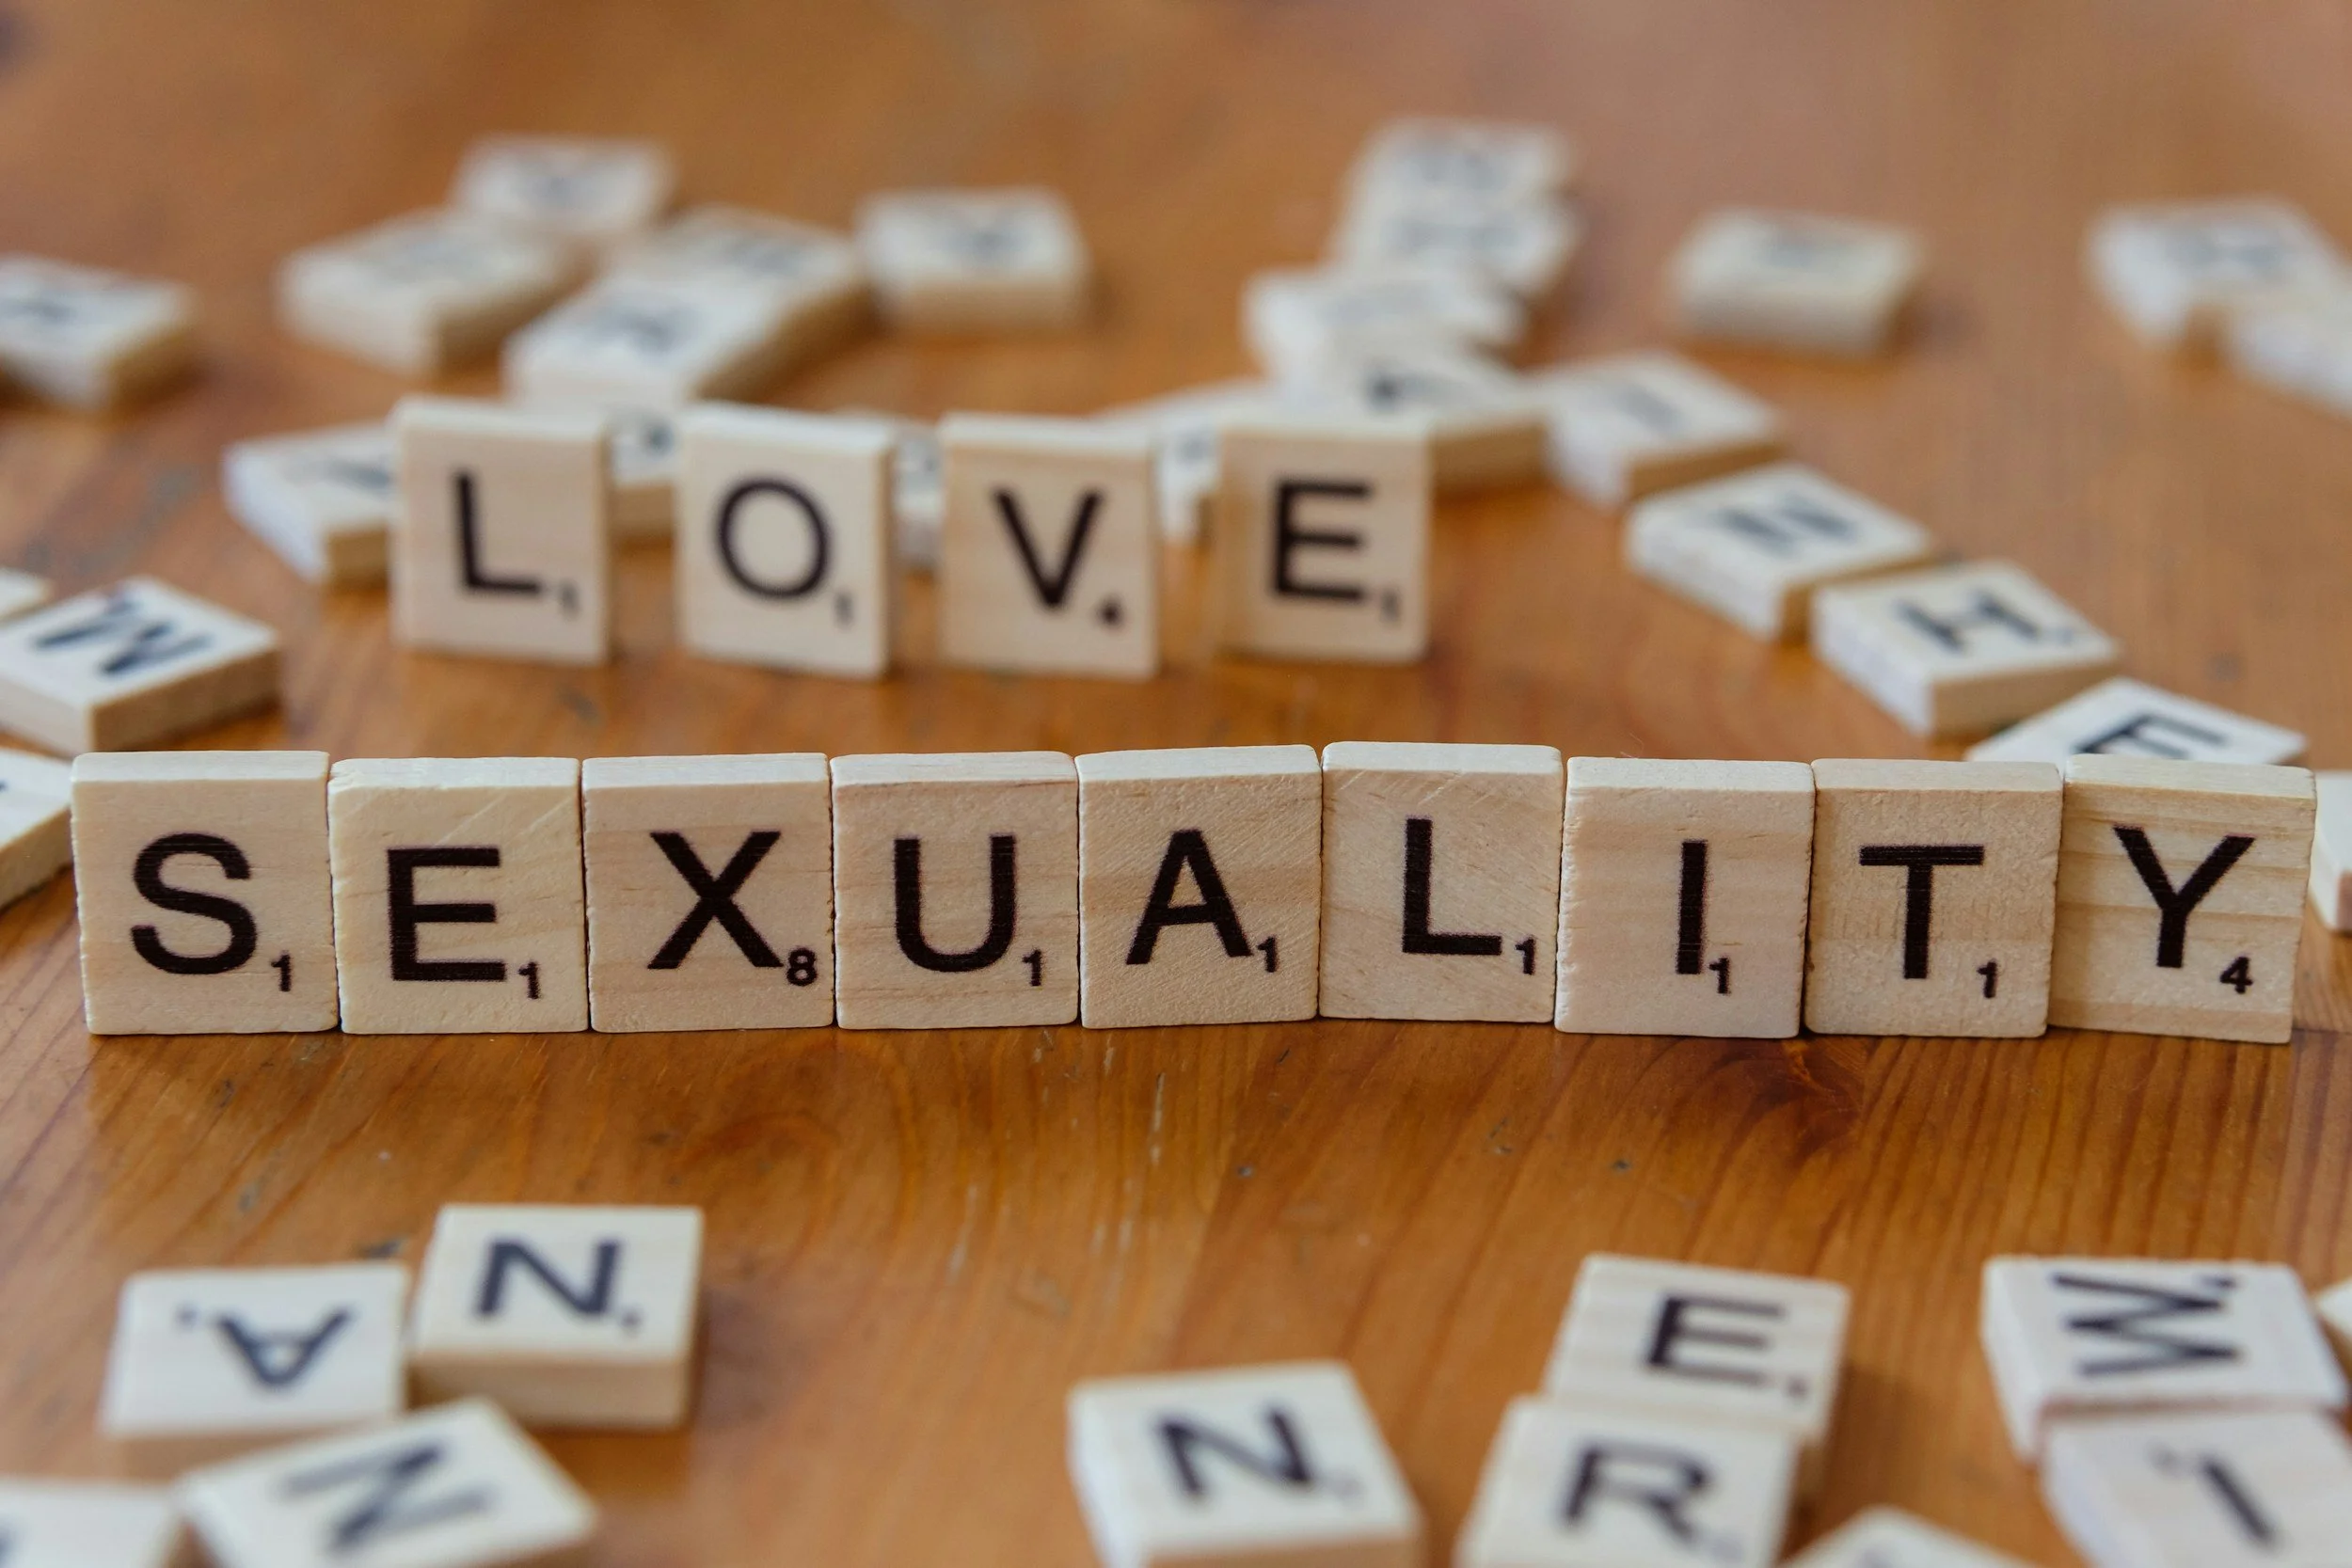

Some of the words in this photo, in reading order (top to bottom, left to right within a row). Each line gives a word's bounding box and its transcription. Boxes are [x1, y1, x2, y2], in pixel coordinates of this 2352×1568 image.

[129, 816, 2258, 984] SEXUALITY
[270, 953, 294, 993] 1
[516, 960, 542, 1001] 1
[785, 945, 819, 989] 8
[1021, 947, 1044, 989] 1
[1254, 934, 1281, 975] 1
[1514, 935, 1537, 977] 1
[1706, 956, 1733, 996] 1
[1975, 959, 1999, 1001] 1
[2218, 955, 2255, 996] 4
[472, 1235, 623, 1321] N
[213, 1303, 356, 1390] A
[1641, 1287, 1790, 1388] E
[1152, 1400, 1321, 1505] N
[1558, 1435, 1720, 1548] R
